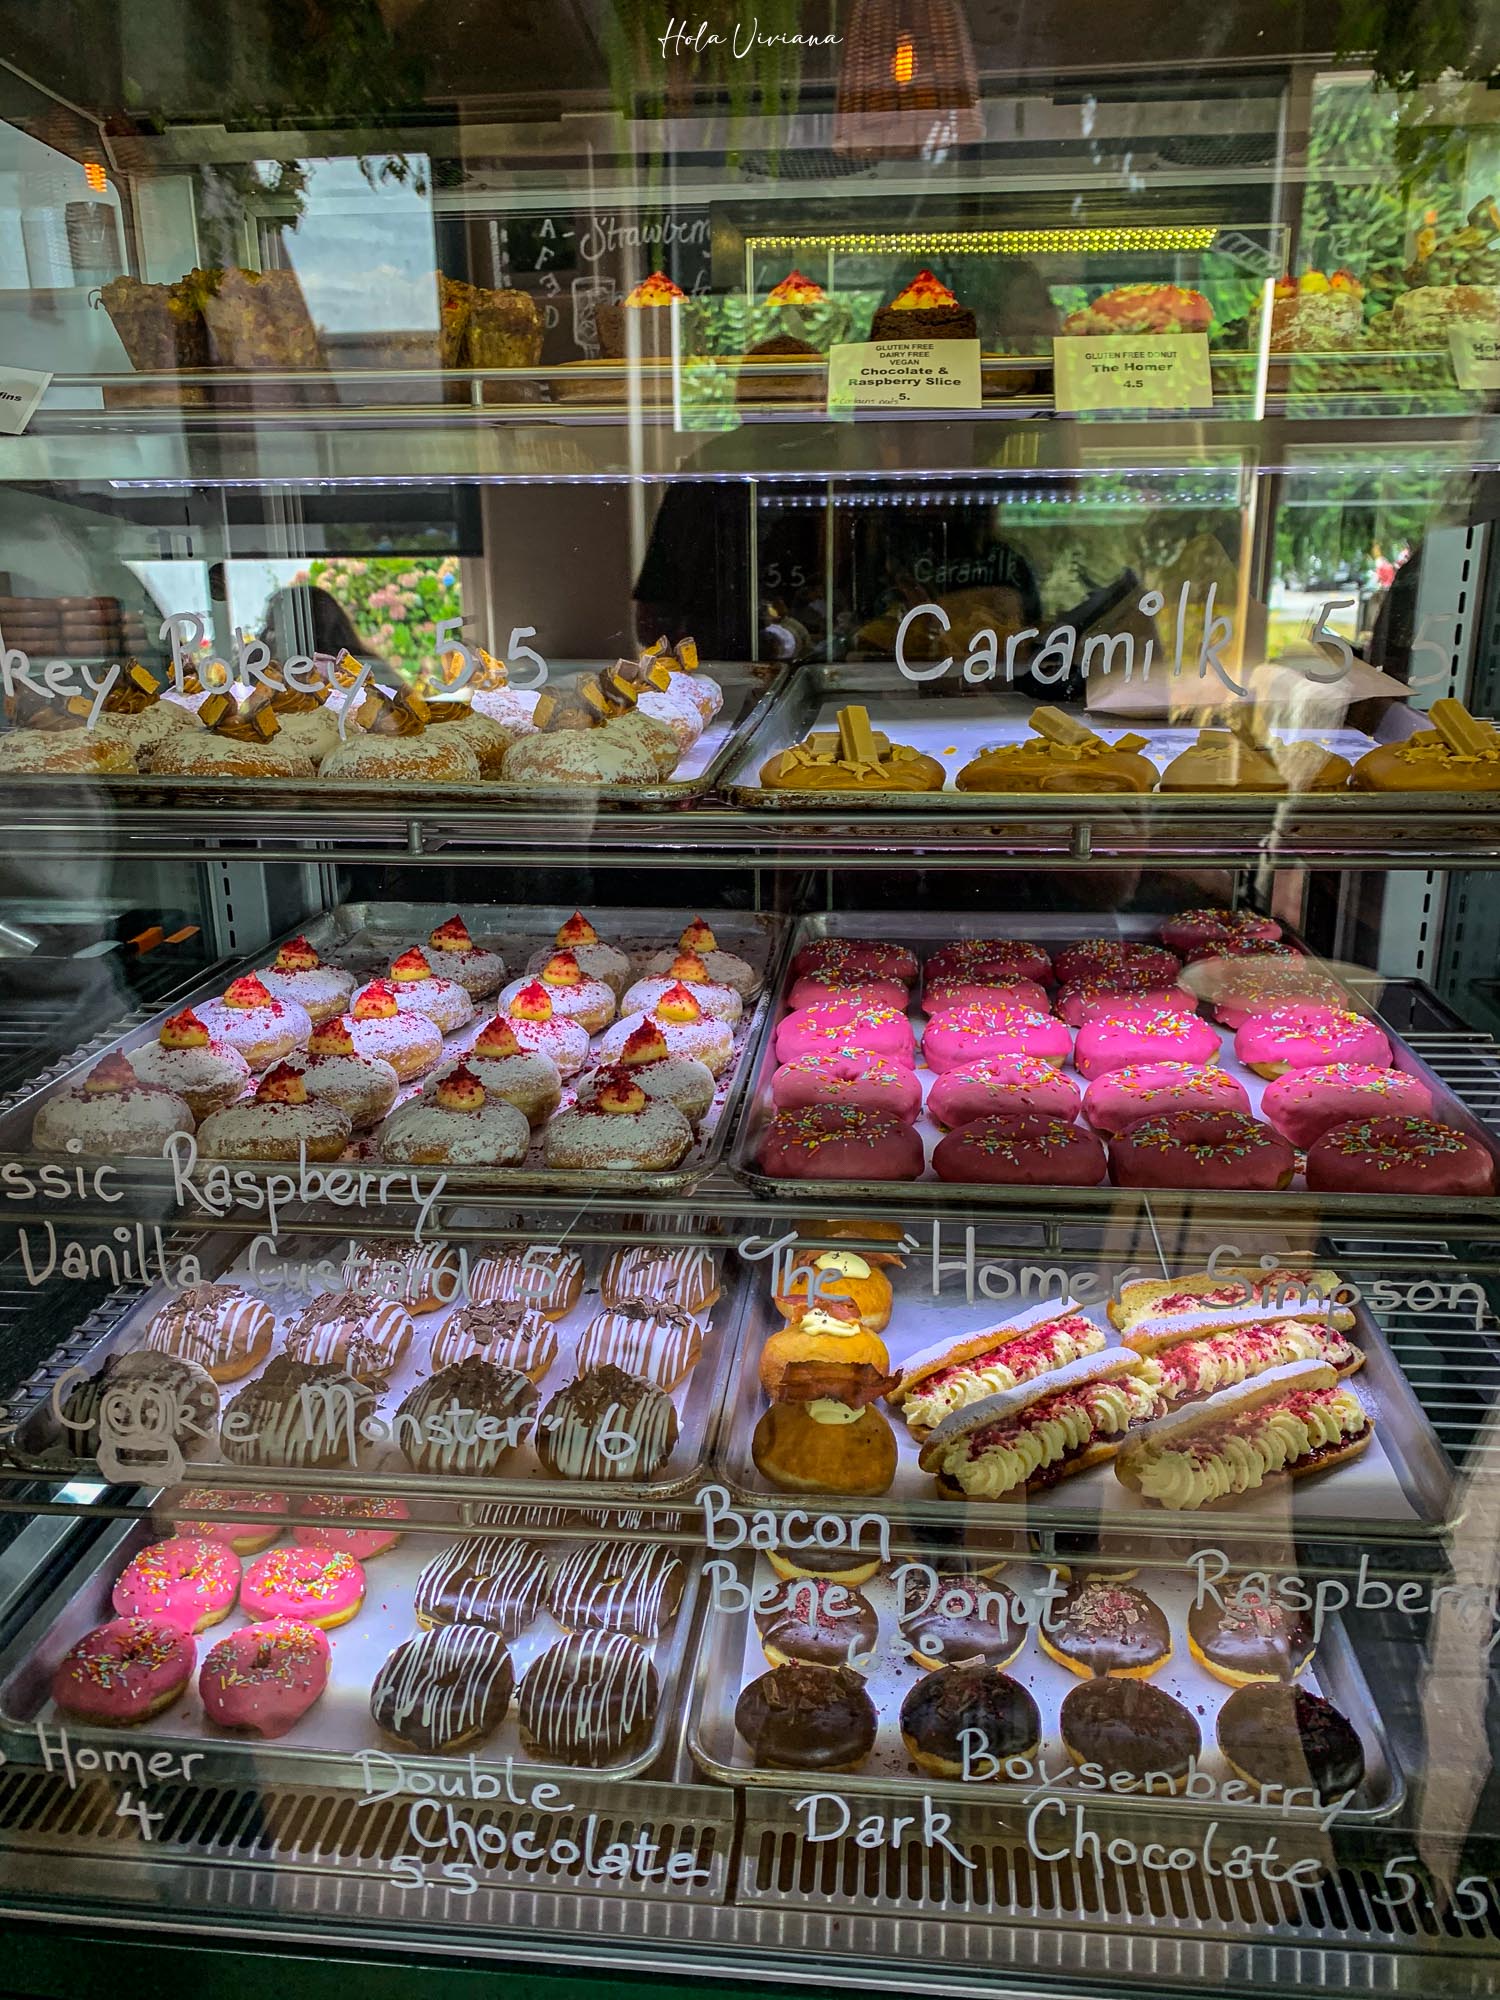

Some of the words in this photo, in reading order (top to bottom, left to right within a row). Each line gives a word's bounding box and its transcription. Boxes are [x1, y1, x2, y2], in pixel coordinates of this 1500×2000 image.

[848, 377, 921, 387] Raspberry
[925, 377, 962, 386] Slice
[860, 367, 933, 376] Chocolate
[937, 366, 949, 375] &
[879, 351, 906, 359] DAIRY
[889, 358, 920, 366] VEGAN
[1085, 352, 1121, 360] GLUTEN
[1147, 351, 1177, 359] DONUT
[1091, 364, 1120, 373] The
[1124, 363, 1173, 372] Homer
[1122, 379, 1144, 389] 4.5
[913, 547, 1021, 587] Caramilk
[895, 580, 1248, 698] Caramilk
[159, 612, 372, 742] Pokey
[1, 1138, 125, 1202] ssic
[163, 1130, 447, 1243] Raspberry
[18, 1219, 202, 1291] Vanilla
[249, 1235, 472, 1304] Custard
[738, 1230, 852, 1308] The
[1201, 1243, 1487, 1343] Simpson
[595, 1402, 637, 1460] 6
[695, 1483, 891, 1563] Bacon
[701, 1559, 862, 1636] Bene
[889, 1563, 1070, 1644] Donut
[36, 1720, 205, 1790] Homer
[351, 1749, 576, 1813] Double
[957, 1727, 1357, 1831] Boysenberry
[115, 1791, 165, 1841] 4
[409, 1798, 711, 1880] Chocolate
[389, 1855, 480, 1896] 5.5
[795, 1793, 979, 1870] Dark
[1027, 1797, 1326, 1889] Chocolate
[1371, 1855, 1491, 1921] 5.5
